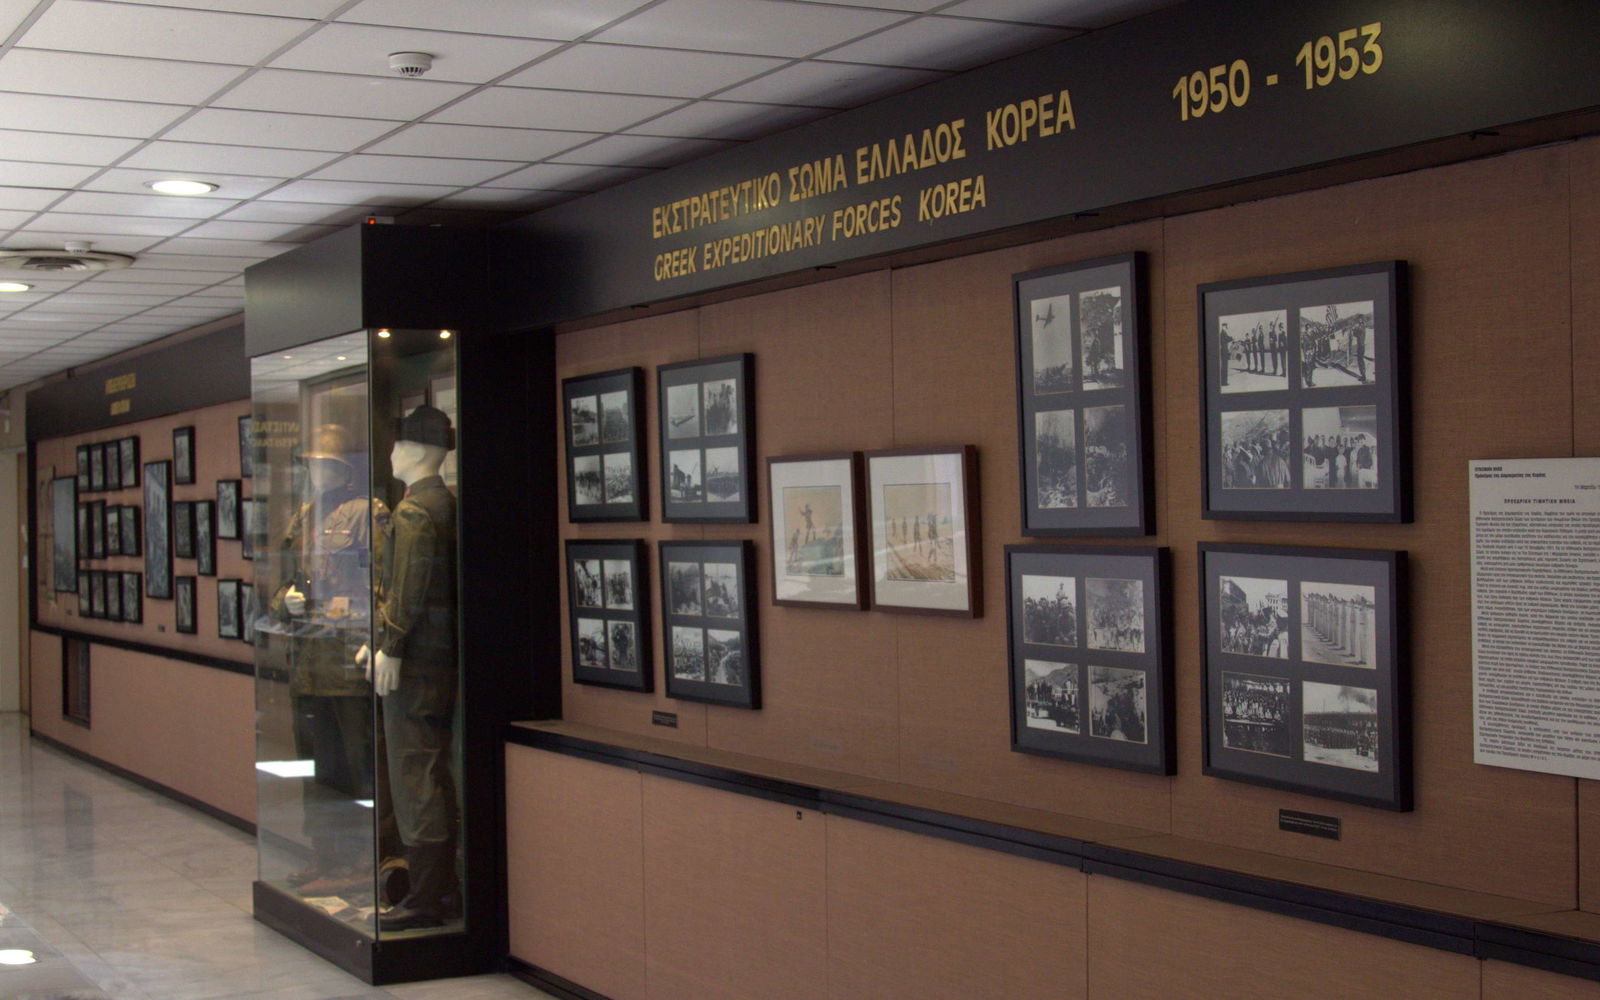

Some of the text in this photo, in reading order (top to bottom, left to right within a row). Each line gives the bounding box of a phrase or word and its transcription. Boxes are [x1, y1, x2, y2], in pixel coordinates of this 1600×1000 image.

[1172, 21, 1384, 121] 1950 - 1953
[653, 89, 1077, 239] ΕΚΣΤΡΑΤΕΥΤΙΚΟ ΣΩΜΑ ΕΛΛΑΔΟΣ ΚΟΡΕΑ
[654, 174, 987, 281] GREEK EXPEDITIONARY FORCES KOREA
